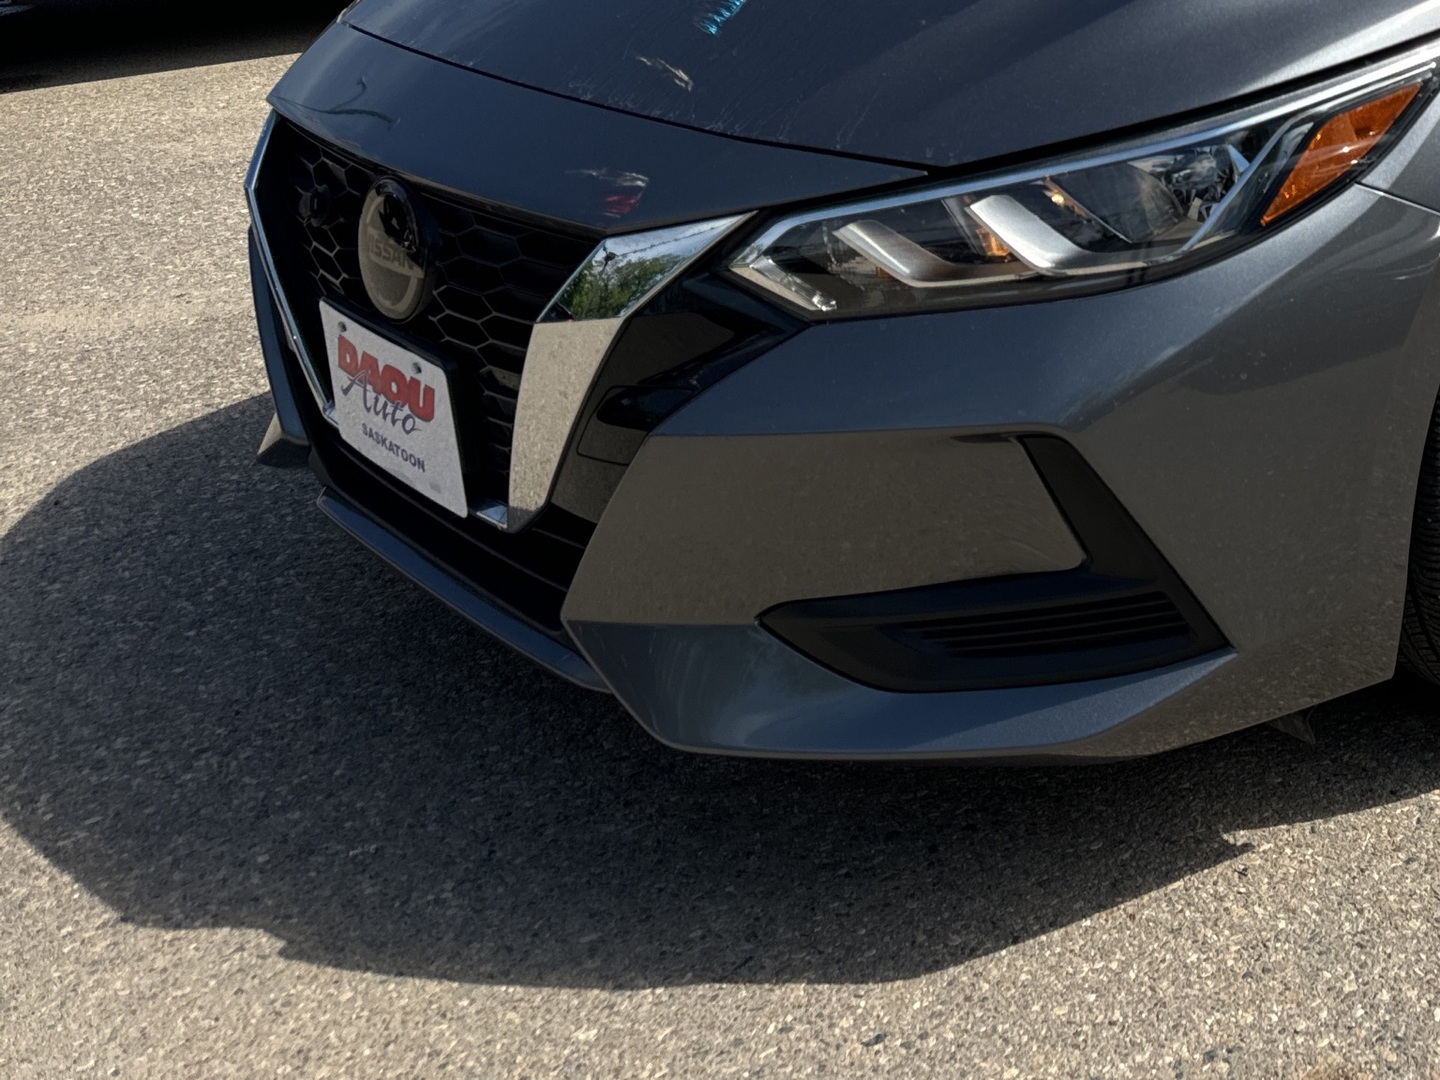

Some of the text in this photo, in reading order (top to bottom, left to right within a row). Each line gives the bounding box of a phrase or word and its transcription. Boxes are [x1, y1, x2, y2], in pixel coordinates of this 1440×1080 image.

[337, 333, 435, 423] DAOU
[341, 369, 422, 435] Auto
[361, 422, 425, 473] SASKATOON
